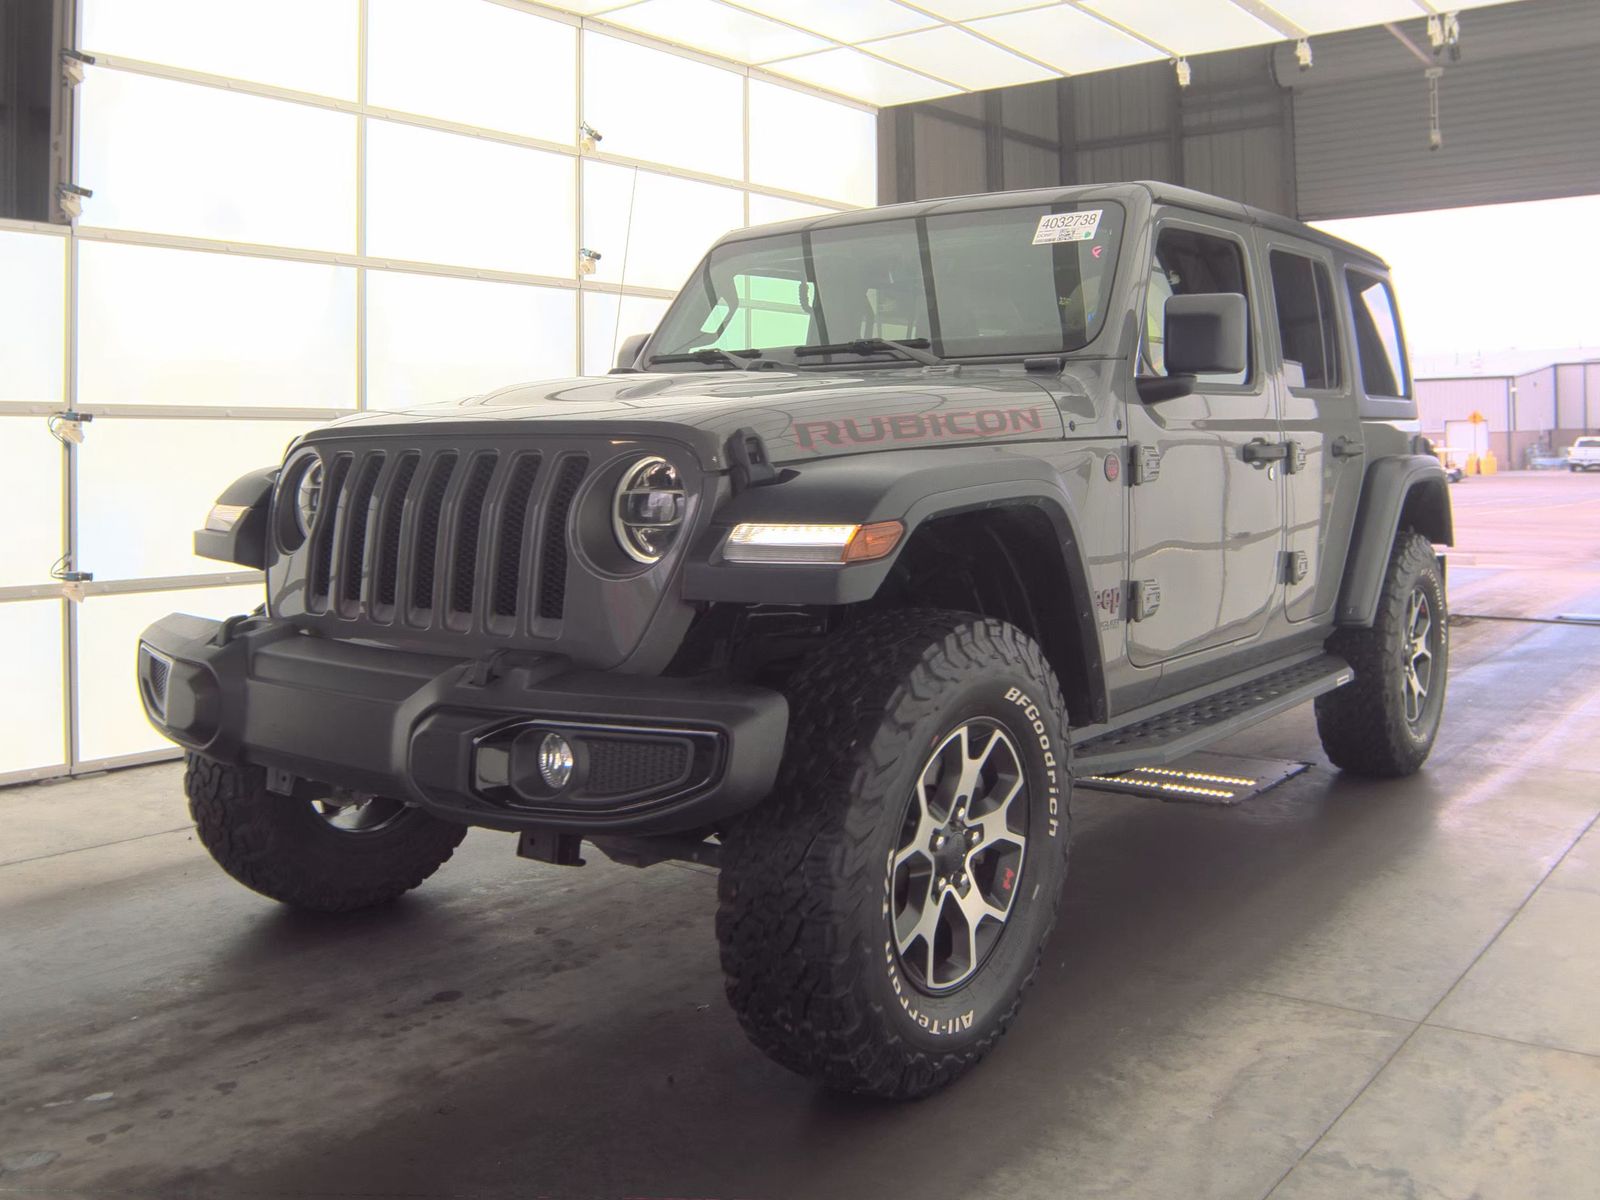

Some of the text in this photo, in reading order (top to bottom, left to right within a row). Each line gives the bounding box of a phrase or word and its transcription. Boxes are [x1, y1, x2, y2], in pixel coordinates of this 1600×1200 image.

[1041, 213, 1098, 229] 4032738
[793, 408, 1043, 450] RUBICON
[1004, 686, 1060, 837] BFGoodrich
[885, 941, 974, 1035] All-Terrain
